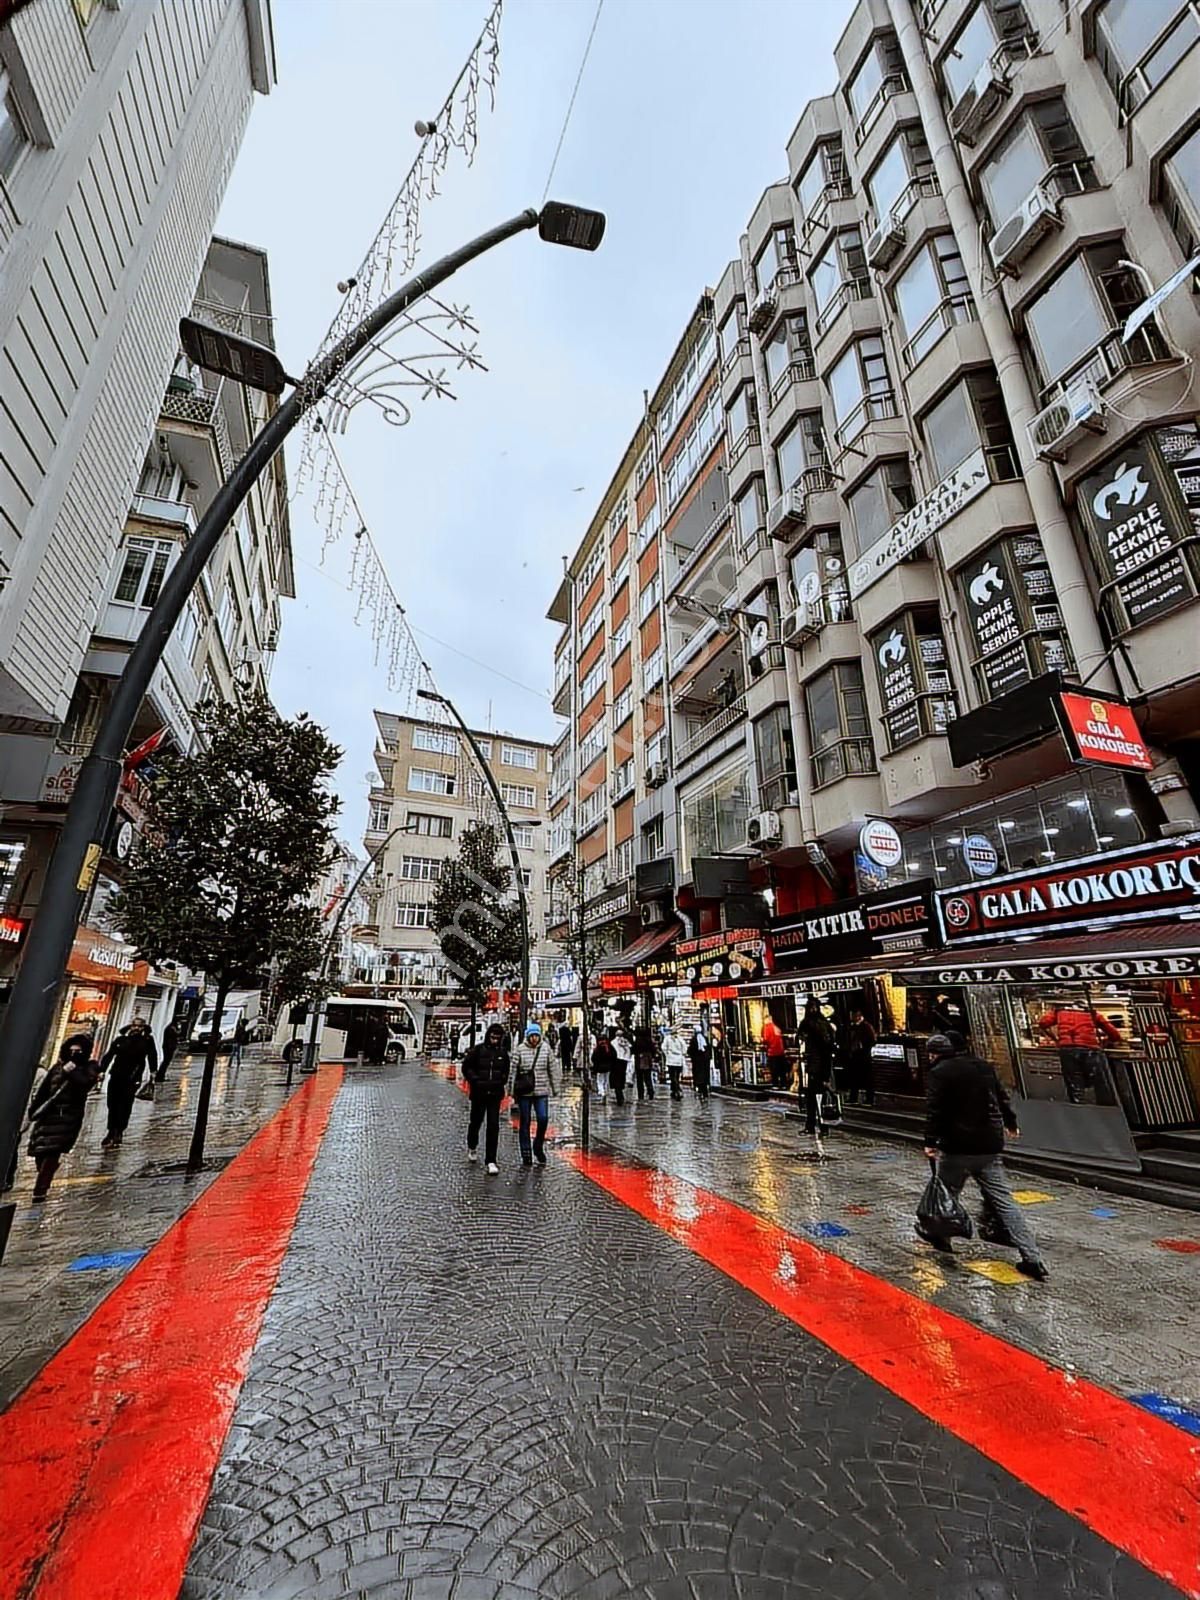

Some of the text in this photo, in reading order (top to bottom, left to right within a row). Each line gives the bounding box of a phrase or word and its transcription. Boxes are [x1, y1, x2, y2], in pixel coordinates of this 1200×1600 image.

[875, 464, 987, 567] OĞUZ FİDAN
[890, 471, 960, 541] AVUKAT
[1107, 502, 1161, 547] APPLE
[1109, 519, 1167, 560] TEKNİK
[1115, 535, 1172, 576] SERVİS
[976, 597, 1014, 630] APPLE
[978, 611, 1017, 641] TEKNİK
[981, 625, 1020, 655] SERVİS
[884, 662, 912, 688] APPLE
[887, 687, 916, 710] SERVİS
[1086, 719, 1125, 739] GALA
[1078, 732, 1145, 761] KOKOREÇ
[981, 856, 1200, 919] GALA KOKOREÇ
[772, 930, 806, 948] HATAY
[806, 910, 865, 940] KITIR
[939, 957, 1200, 983] GALA KOKORE
